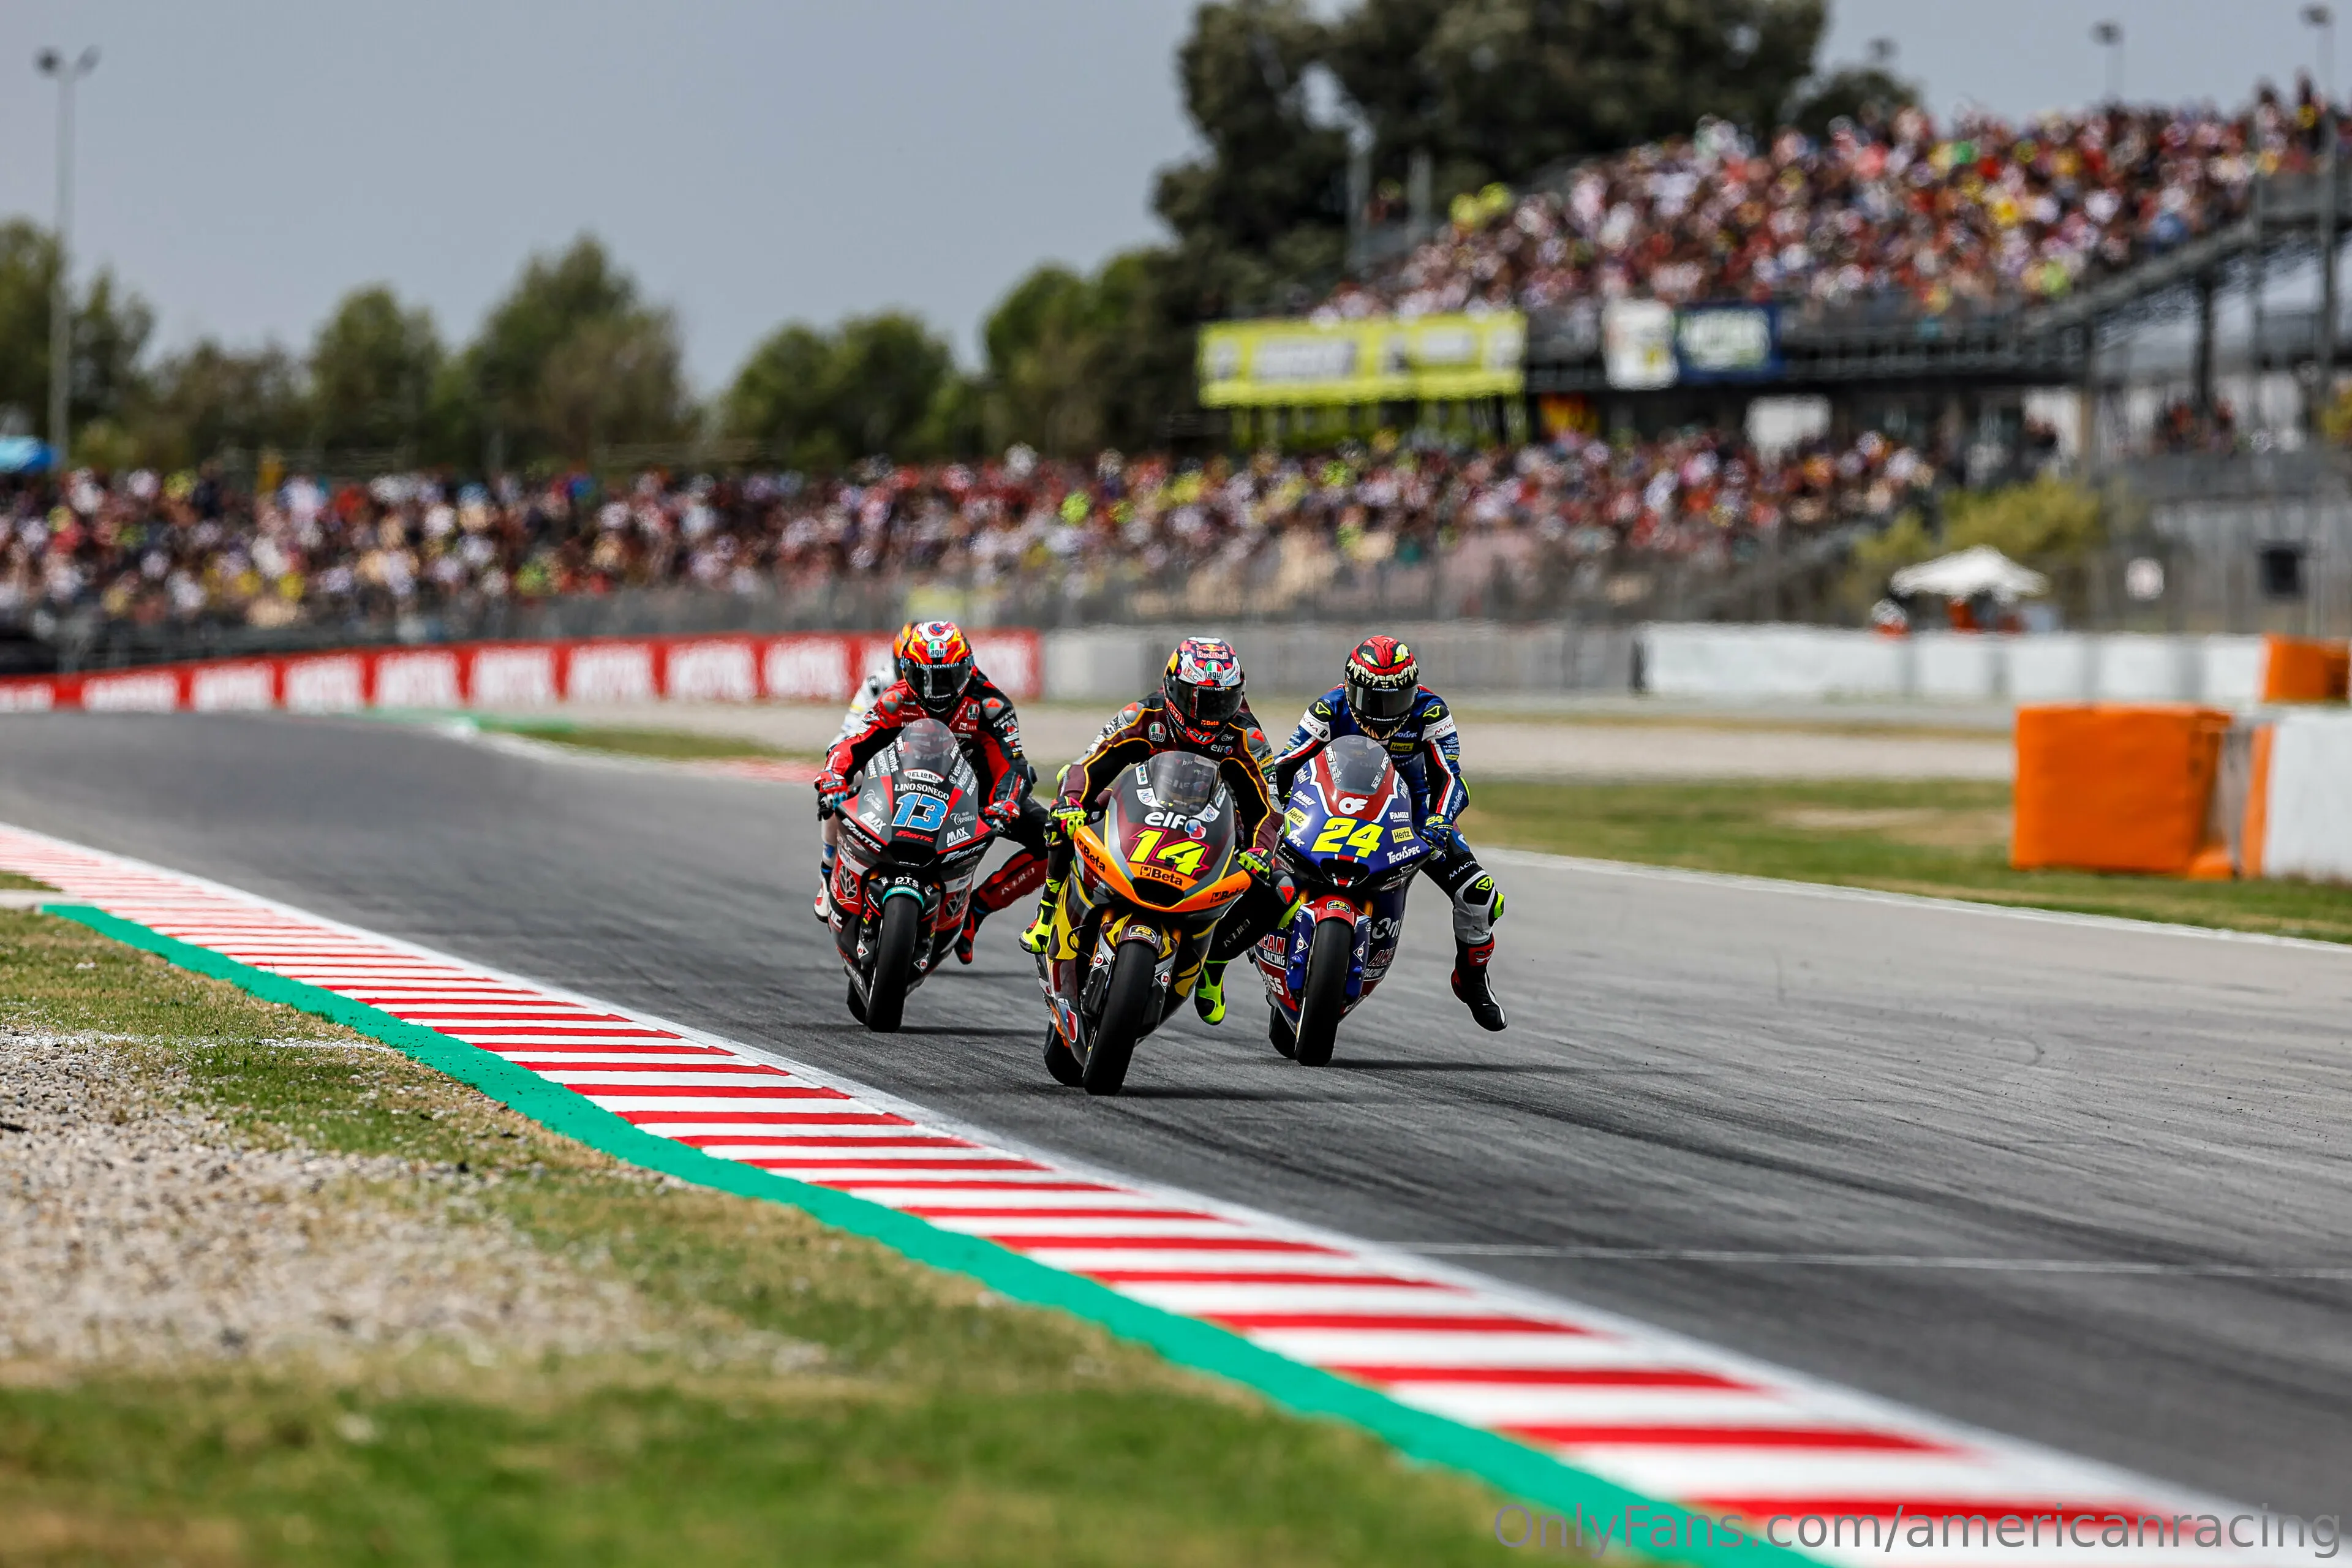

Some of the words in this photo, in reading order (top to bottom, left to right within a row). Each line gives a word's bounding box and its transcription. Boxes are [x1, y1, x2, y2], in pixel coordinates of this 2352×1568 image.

[1208, 671, 1221, 680] agv
[1151, 732, 1164, 742] agv
[1210, 744, 1225, 753] elf
[894, 783, 916, 791] LINO
[916, 783, 949, 801] SONEGO
[891, 792, 949, 832] 13
[1144, 811, 1188, 829] elf
[1288, 809, 1305, 824] Hertz
[1389, 812, 1409, 820] FAMILY
[1425, 815, 1444, 826] 24
[946, 827, 969, 844] MAX
[1311, 817, 1384, 858] 24
[1393, 830, 1411, 840] Hertz
[1083, 845, 1106, 873] Beta
[1126, 827, 1210, 878] 14
[1151, 867, 1183, 886] Beta
[1264, 949, 1285, 967] RACING
